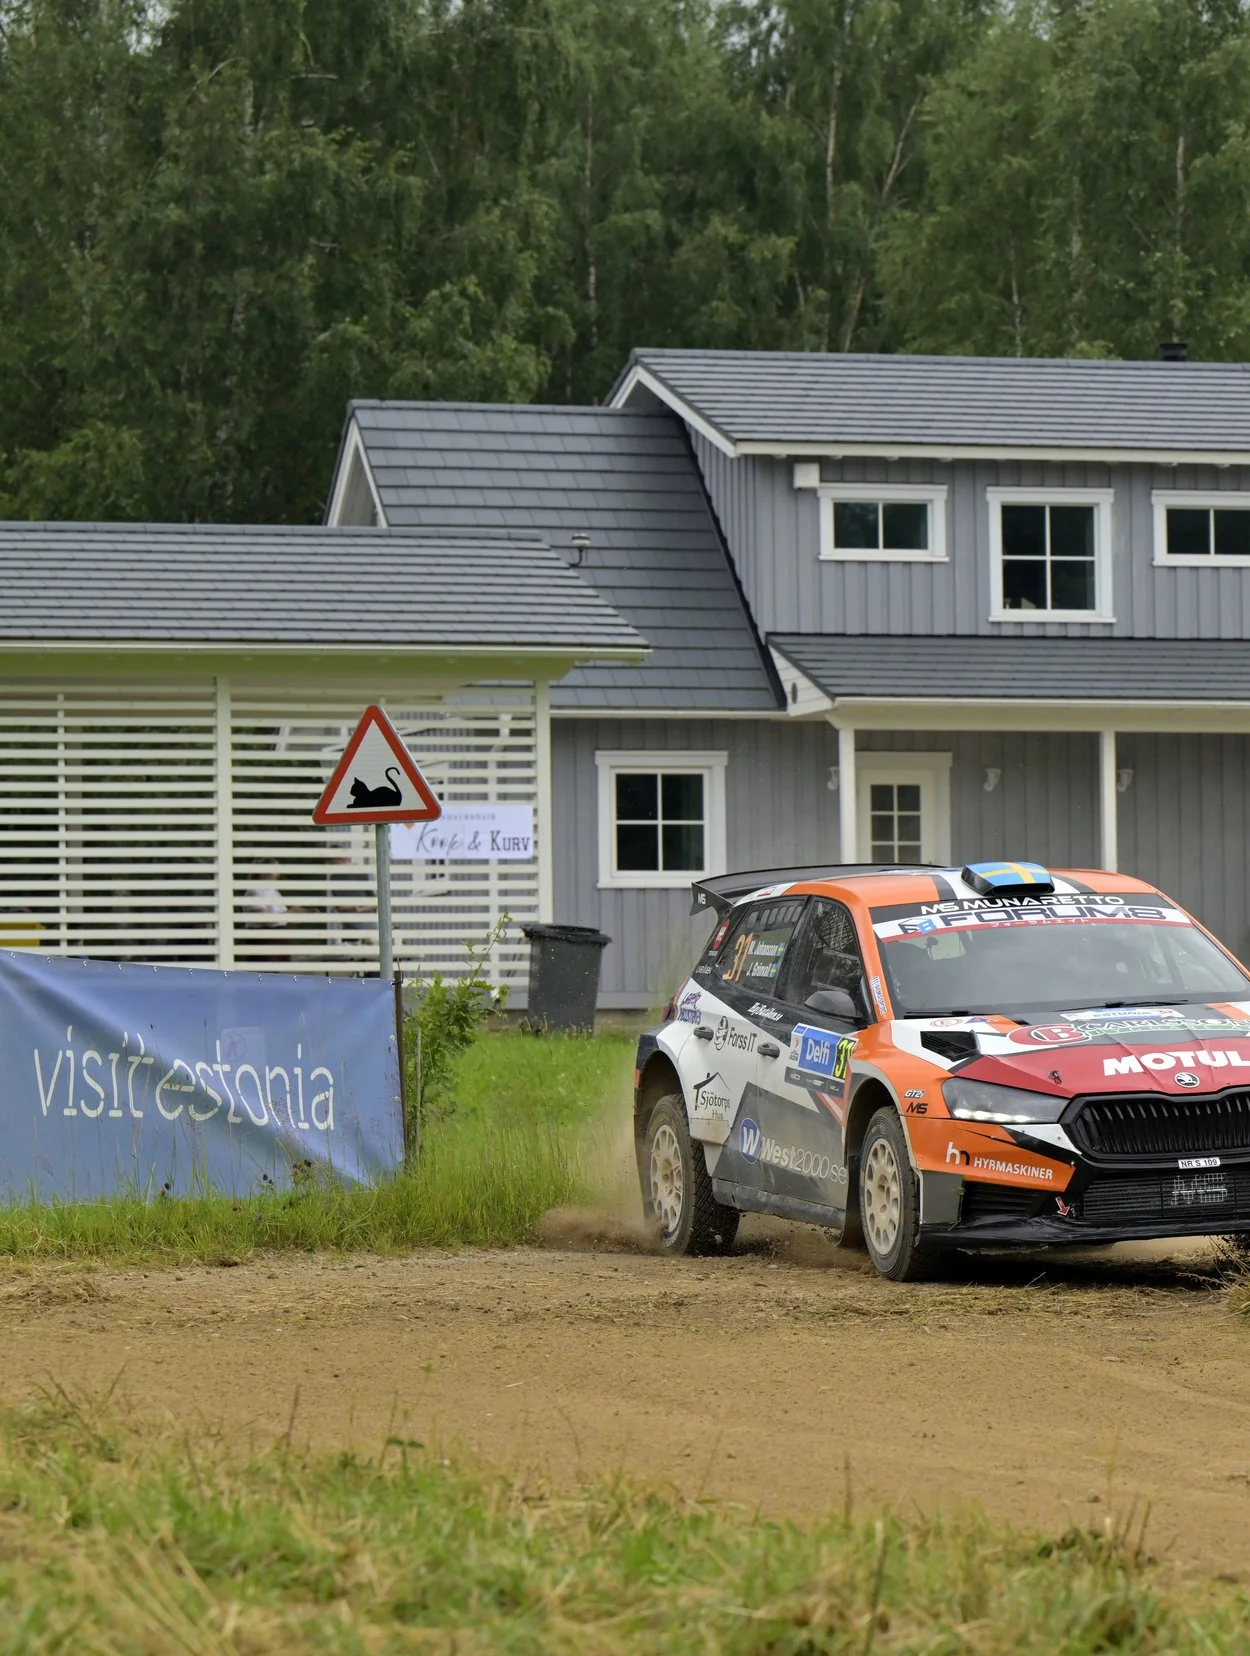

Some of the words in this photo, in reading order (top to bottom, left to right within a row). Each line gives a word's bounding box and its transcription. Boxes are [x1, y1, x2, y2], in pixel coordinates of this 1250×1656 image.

[467, 831, 481, 851] &
[921, 902, 959, 915] MS
[963, 896, 1125, 911] MUNARETTO
[940, 906, 1167, 927] FORUM8
[722, 932, 753, 982] 31
[728, 1027, 747, 1051] Forss
[747, 1033, 758, 1053] IT
[806, 1038, 831, 1066] Delfi
[835, 1039, 855, 1079] 31
[34, 1025, 154, 1118] visit
[156, 1039, 335, 1131] estonia
[700, 1090, 731, 1113] Sjötorps
[906, 1102, 928, 1114] MS
[974, 1156, 1053, 1180] HYRMASKINER
